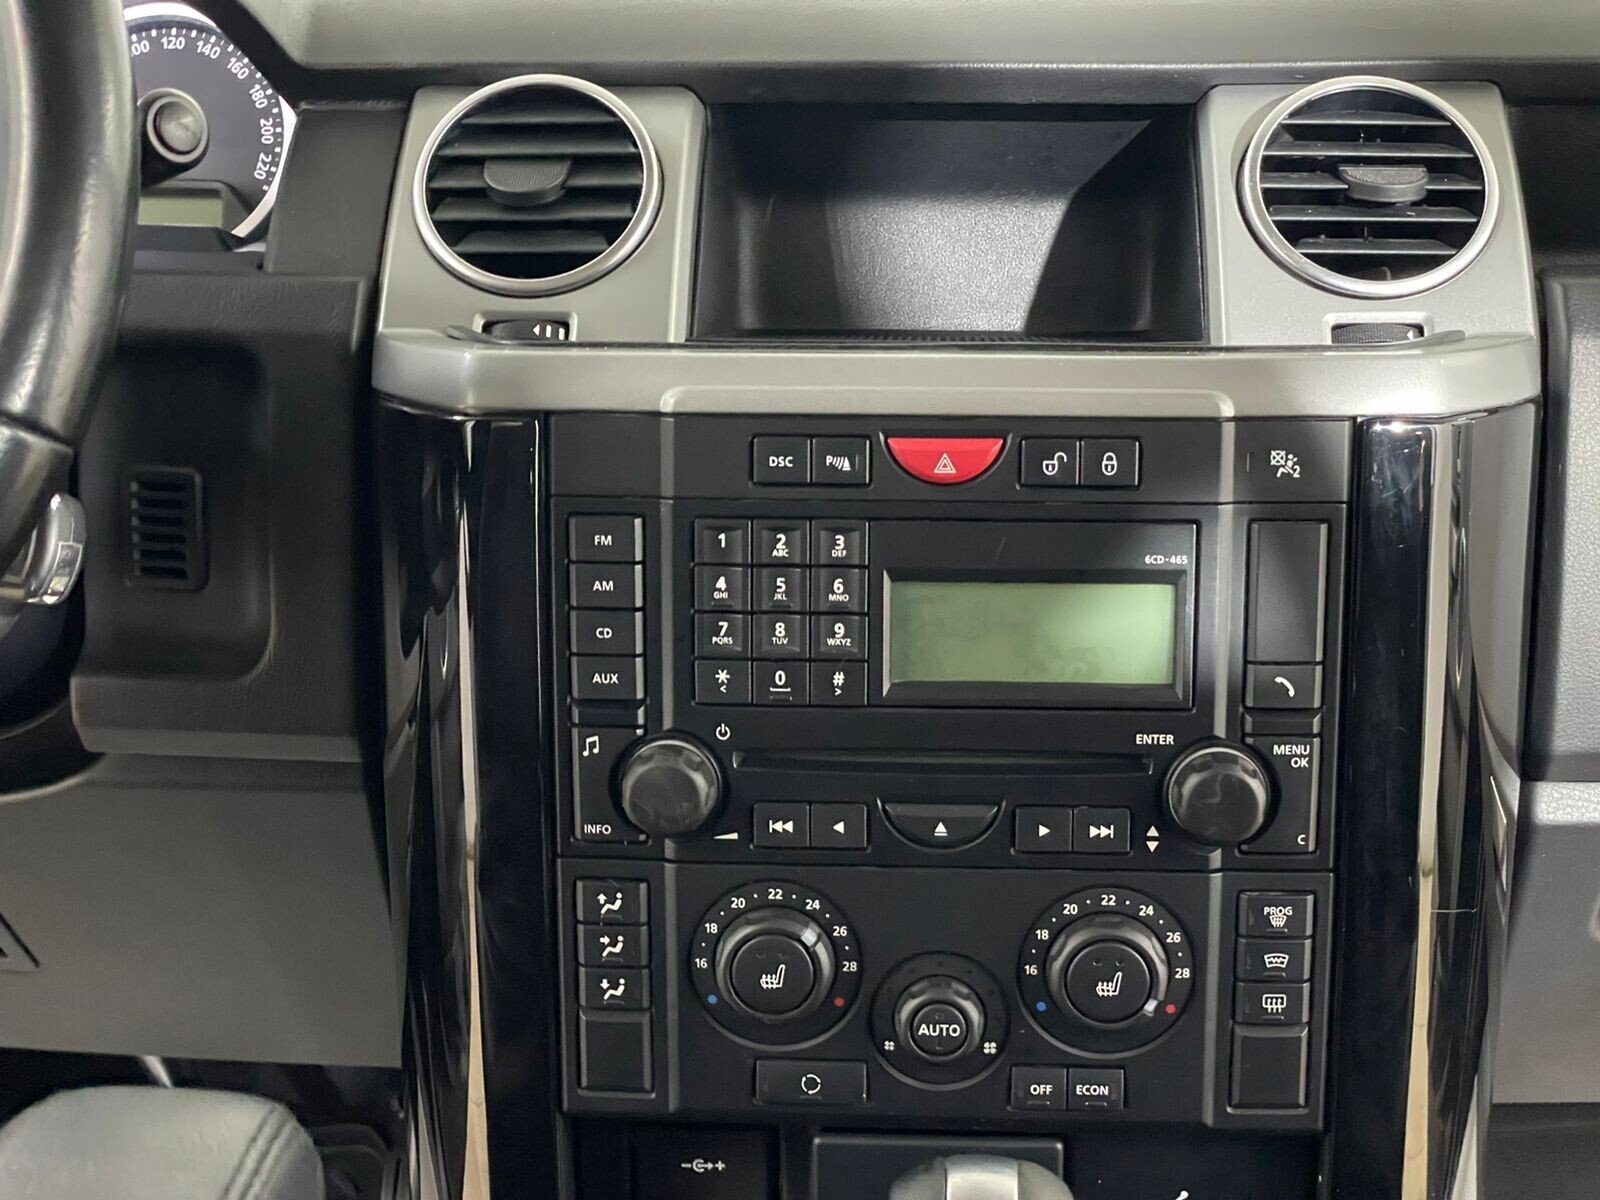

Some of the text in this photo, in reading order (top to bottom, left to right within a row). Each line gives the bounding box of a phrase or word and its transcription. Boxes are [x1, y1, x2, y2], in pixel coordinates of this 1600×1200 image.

[131, 40, 150, 56] 00
[160, 37, 185, 49] 120
[196, 40, 222, 59] 140
[226, 57, 249, 79] 160
[249, 84, 268, 109] 180
[260, 118, 273, 144] 200
[254, 152, 272, 180] 220
[769, 456, 793, 467] DSC
[595, 535, 611, 545] FM
[718, 533, 725, 547] 1
[775, 534, 787, 549] 2
[834, 535, 845, 549] 3
[772, 548, 788, 557] ABC
[832, 548, 846, 557] DEF
[593, 581, 613, 591] AM
[715, 576, 727, 591] 4
[775, 578, 786, 593] 5
[834, 578, 845, 593] 6
[714, 590, 728, 599] GHI
[774, 591, 787, 600] JKL
[829, 592, 849, 601] MNO
[596, 628, 612, 638] CD
[718, 622, 728, 636] 7
[774, 623, 786, 637] 8
[833, 623, 845, 638] 9
[712, 635, 733, 644] PQRS
[772, 636, 788, 644] TUV
[827, 637, 851, 646] WXYZ
[593, 673, 618, 683] AUX
[775, 671, 785, 685] 0
[1136, 734, 1173, 744] ENTER
[1274, 745, 1309, 755] MENU
[1291, 757, 1309, 767] OK
[585, 824, 611, 834] INFO
[1298, 835, 1305, 844] C
[768, 889, 782, 899] 22
[731, 898, 745, 908] 20
[806, 899, 820, 910] 24
[1101, 895, 1115, 905] 22
[1063, 904, 1078, 914] 20
[1139, 905, 1154, 916] 24
[1263, 906, 1293, 916] PROG
[705, 923, 717, 933] 18
[833, 926, 847, 936] 26
[1036, 930, 1048, 939] 18
[1166, 932, 1181, 942] 26
[695, 958, 707, 968] 16
[843, 961, 857, 971] 28
[1025, 965, 1037, 975] 16
[1175, 968, 1190, 978] 28
[918, 1024, 960, 1036] AUTO
[1030, 1085, 1052, 1094] OFF
[1076, 1085, 1108, 1095] ECON
